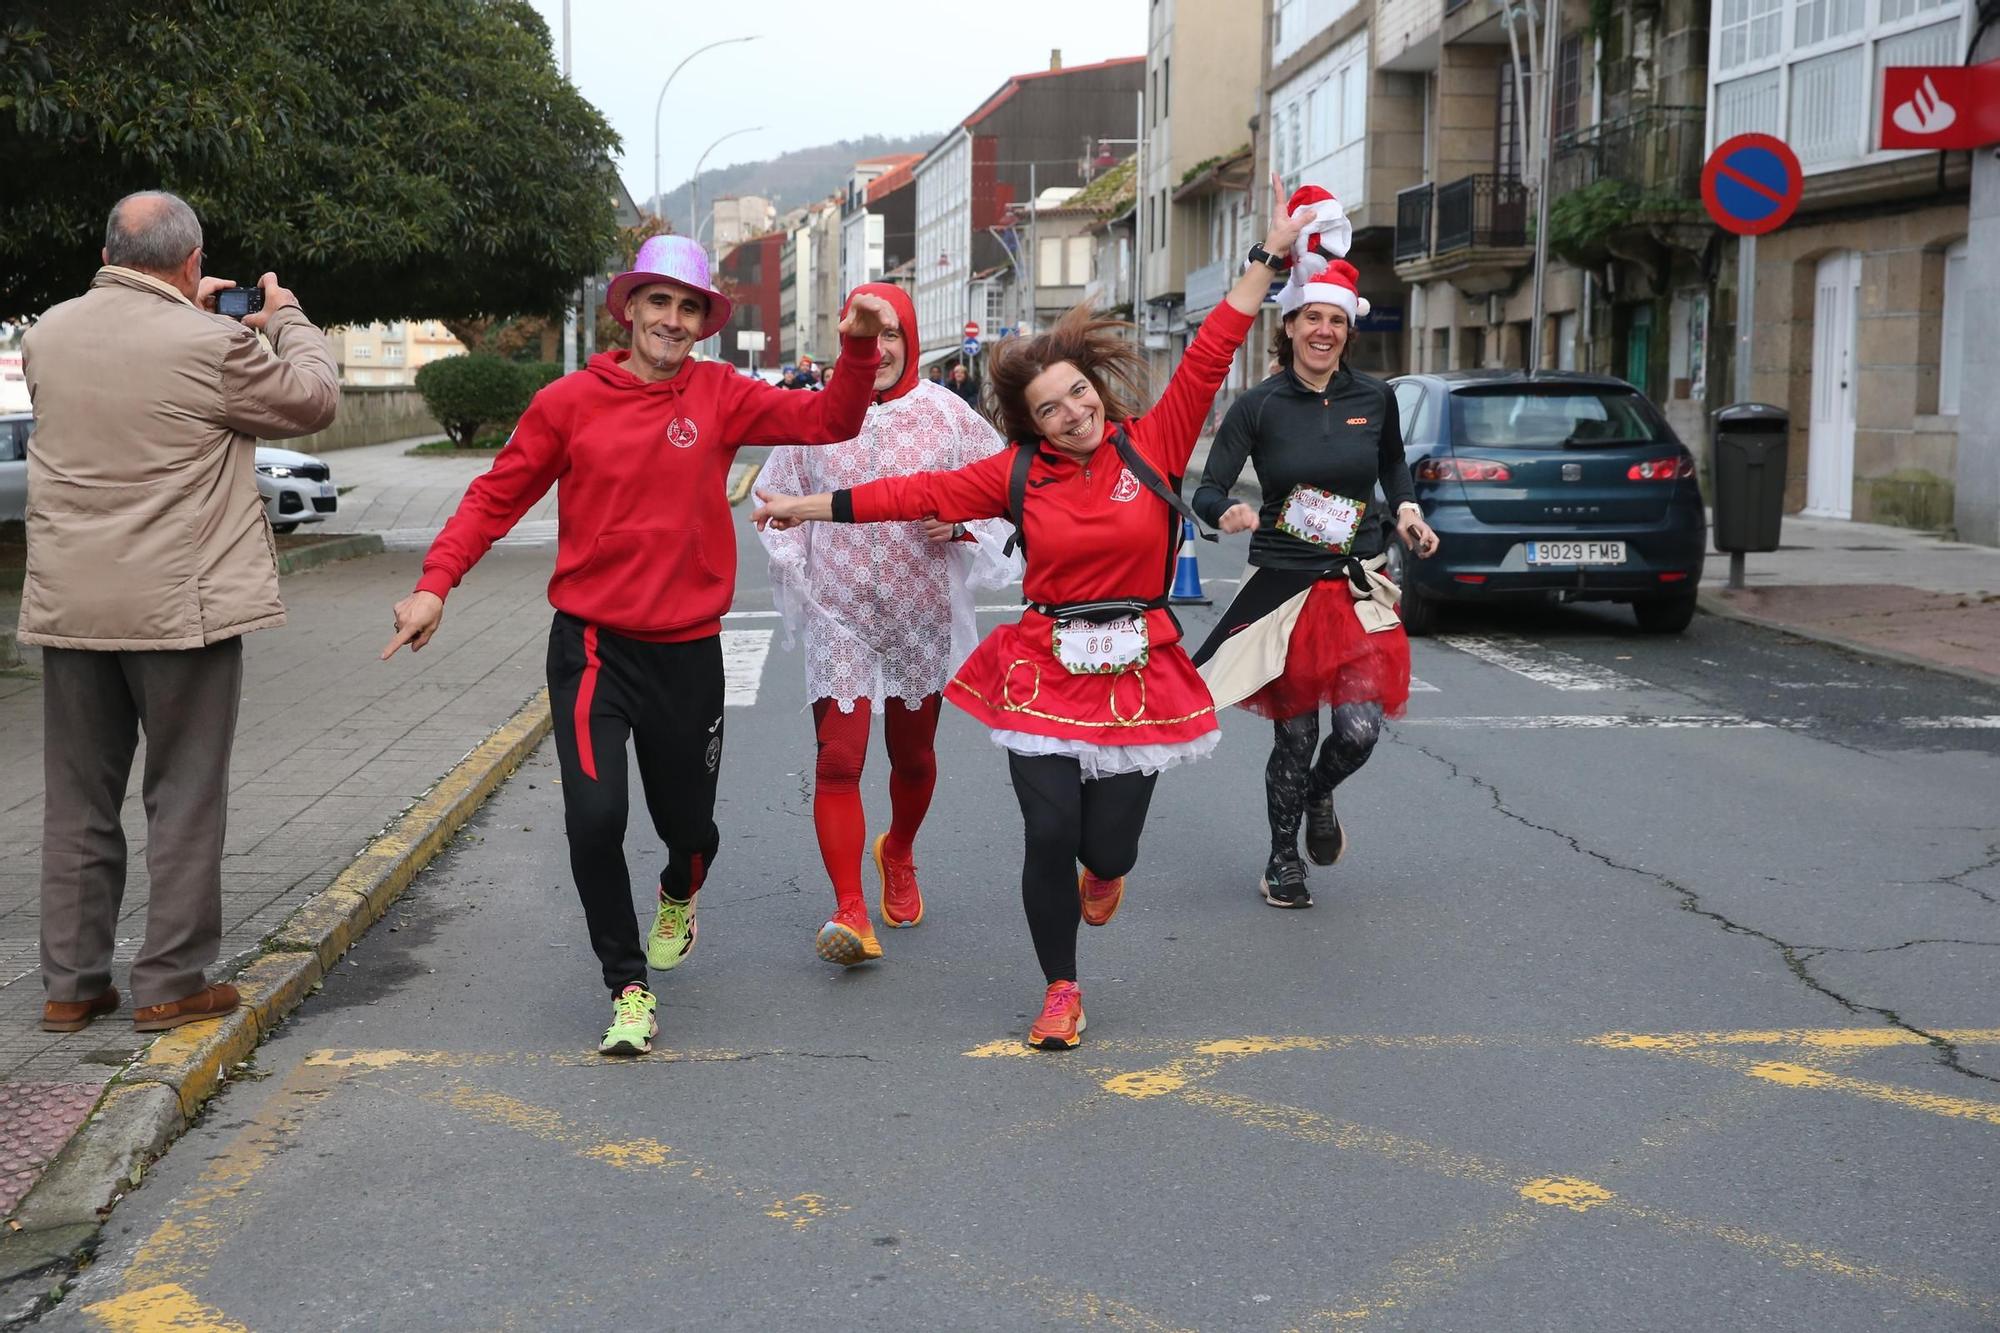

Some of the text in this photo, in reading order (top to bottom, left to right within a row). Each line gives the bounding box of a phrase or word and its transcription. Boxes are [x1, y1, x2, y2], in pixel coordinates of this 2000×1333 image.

[1304, 513, 1328, 532] 65
[1540, 543, 1620, 560] 9029 FMB
[1087, 636, 1113, 654] 66
